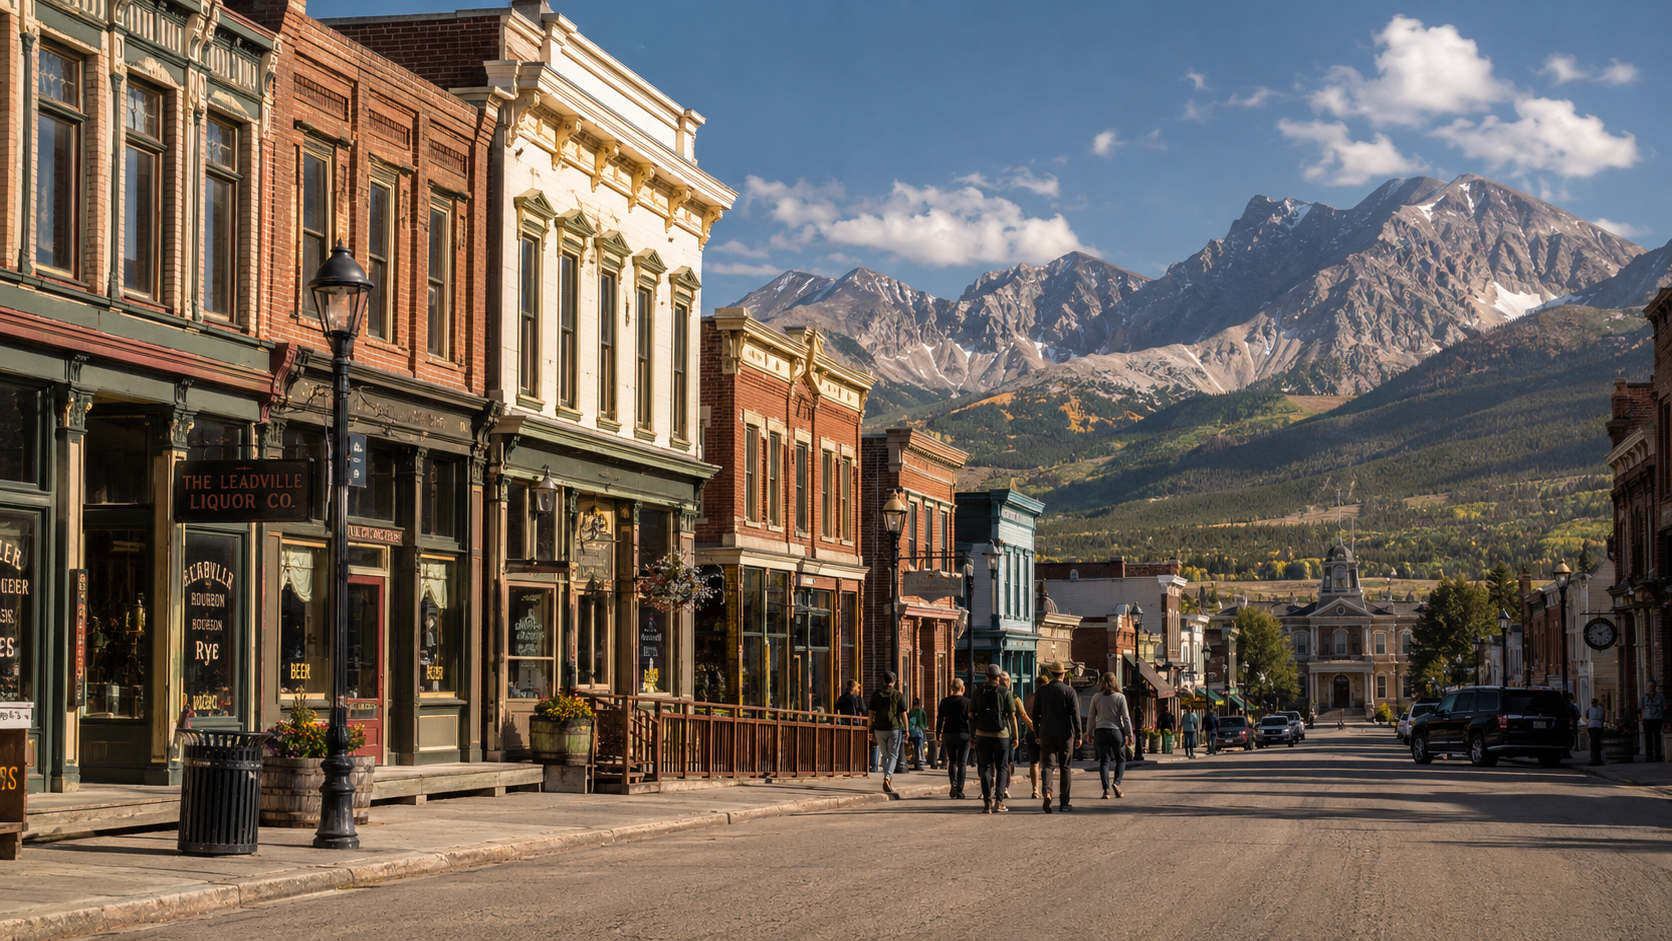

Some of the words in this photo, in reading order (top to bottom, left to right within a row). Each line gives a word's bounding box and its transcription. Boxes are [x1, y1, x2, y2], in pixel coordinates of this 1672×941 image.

[183, 475, 212, 490] THE
[220, 474, 303, 489] LEADVILLE
[190, 493, 256, 511] LIQUOR
[267, 493, 296, 509] CO.
[290, 662, 311, 679] BEER
